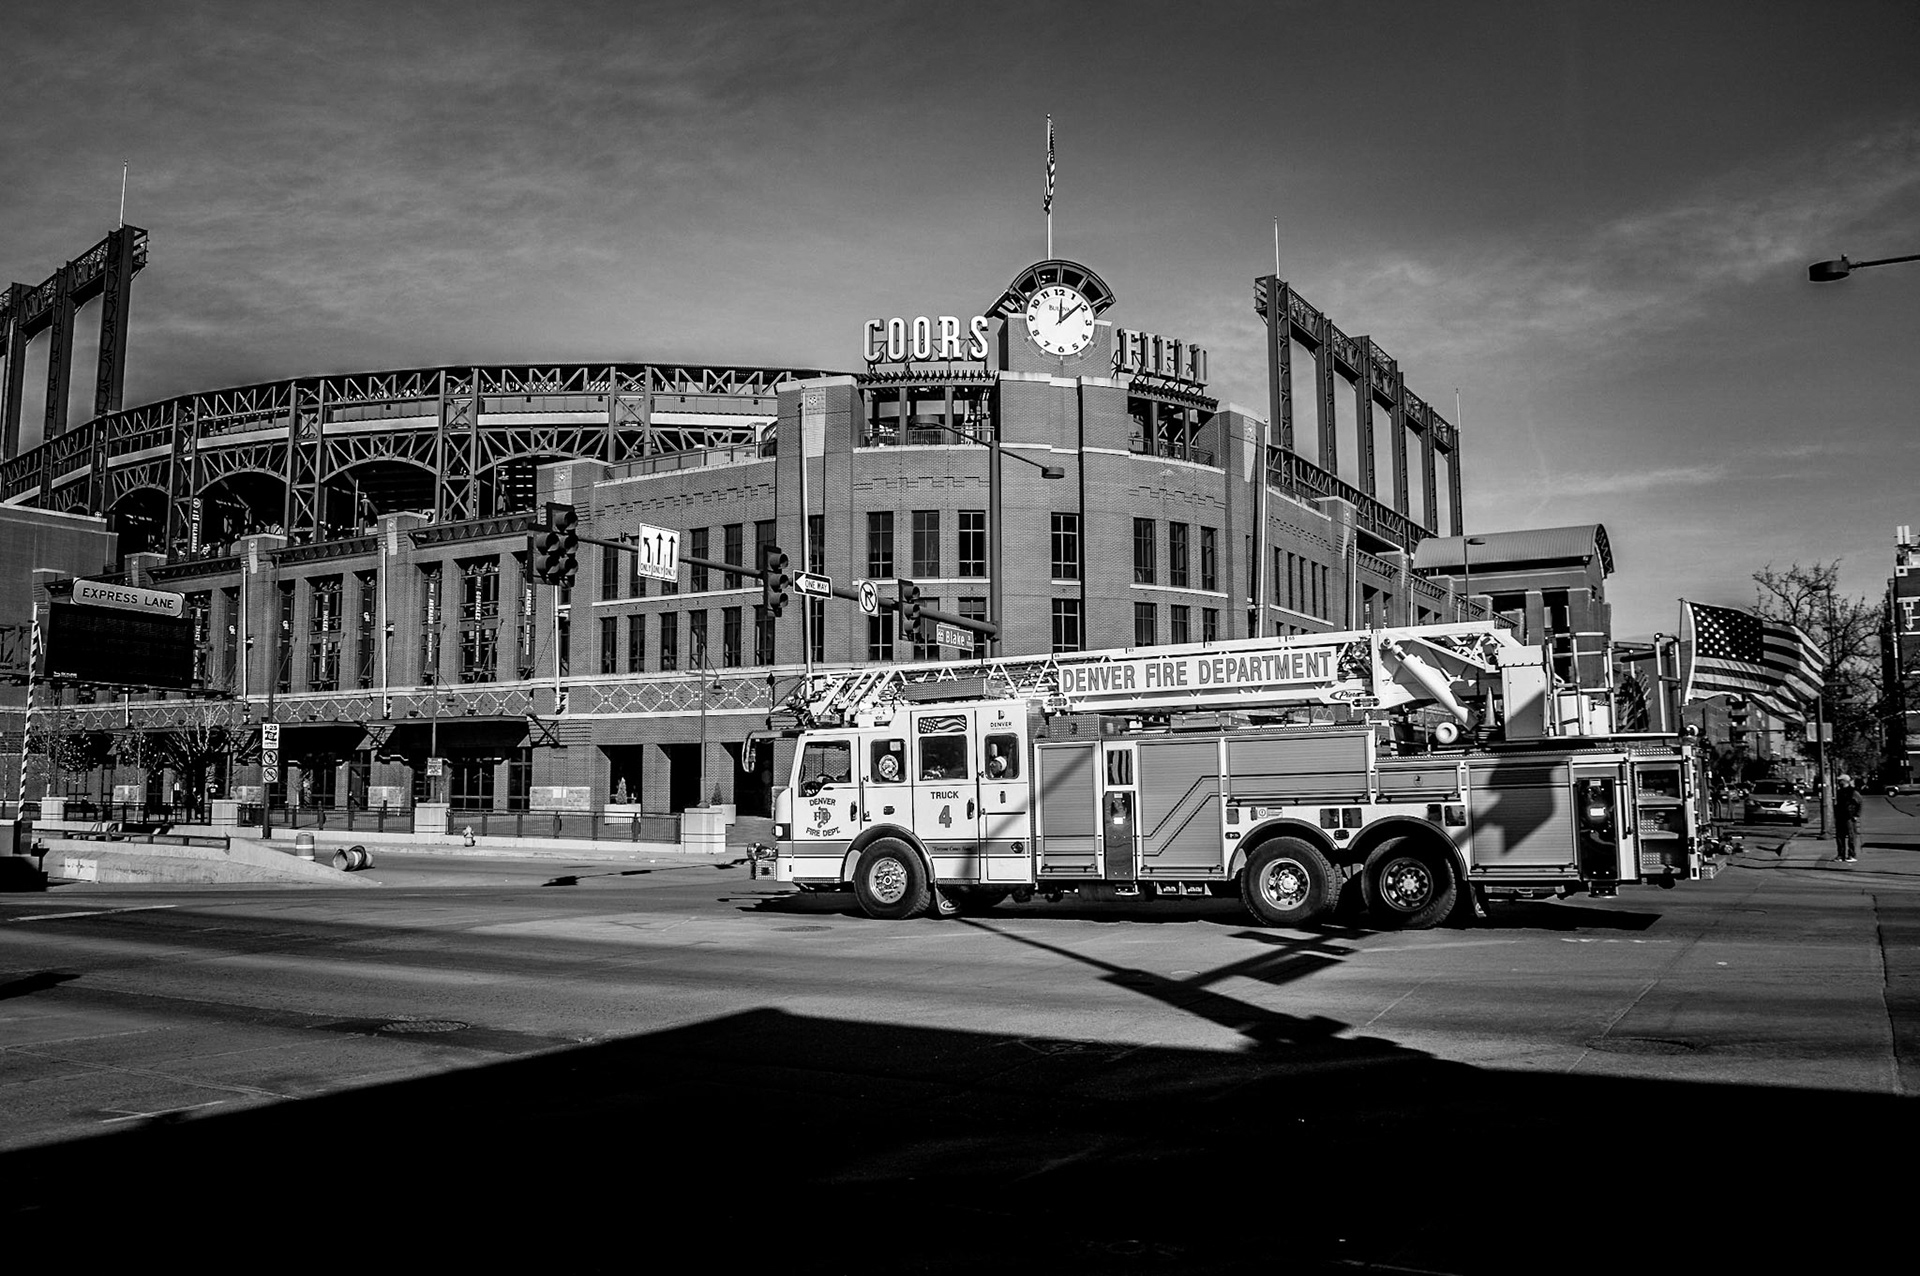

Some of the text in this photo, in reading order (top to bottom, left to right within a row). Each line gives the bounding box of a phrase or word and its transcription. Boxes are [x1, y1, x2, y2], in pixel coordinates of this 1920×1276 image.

[1040, 290, 1050, 300] 11
[1054, 289, 1065, 297] 12
[1030, 298, 1040, 310] 10
[1082, 334, 1088, 342] 4
[862, 315, 1207, 386] COORS FIELD
[1072, 342, 1079, 350] 5
[804, 580, 828, 591] ONE WAY
[82, 587, 174, 609] EXPRESS LANE
[946, 630, 965, 646] Blake
[1062, 651, 1332, 692] DENVER FIRE DEPARTMENT
[930, 790, 959, 800] TRUCK
[810, 798, 836, 806] DENVER
[938, 805, 952, 828] 4
[806, 827, 820, 837] FIRE
